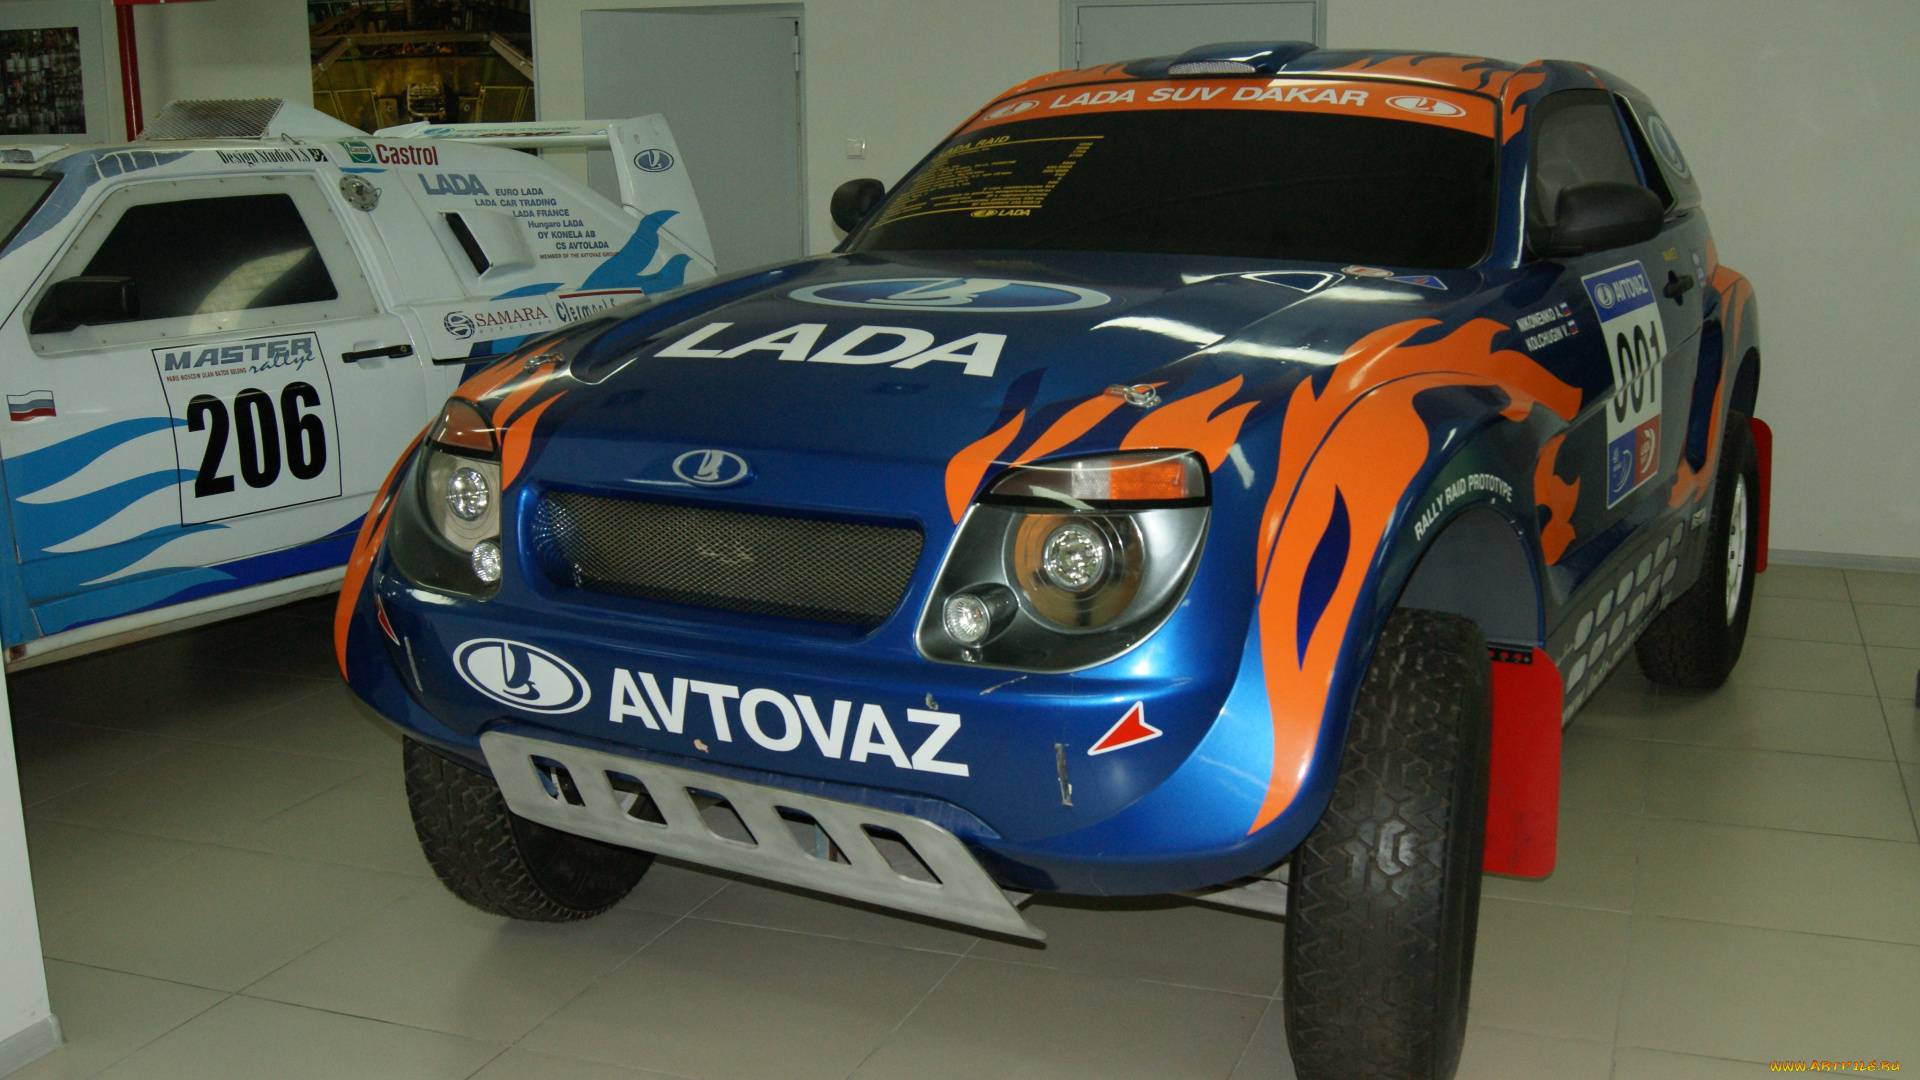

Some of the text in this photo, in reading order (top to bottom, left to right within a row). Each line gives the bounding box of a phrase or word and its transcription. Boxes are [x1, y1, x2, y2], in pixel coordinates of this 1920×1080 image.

[1049, 87, 1369, 109] LADA SUV DAKAR
[976, 135, 1010, 148] RAID
[215, 150, 259, 168] Design
[254, 148, 294, 163] Studio
[375, 144, 439, 166] Castrol
[417, 173, 489, 195] LADA
[495, 187, 544, 196] EURO LADA
[500, 199, 518, 207] CAR
[518, 198, 557, 206] TRADING
[513, 209, 570, 218] LADA FRANCE
[528, 219, 585, 230] Hungaro LADA
[537, 231, 549, 239] OY
[552, 231, 583, 239] KONELA
[556, 241, 610, 250] CS AVTOLADA
[1612, 273, 1649, 302] AVTOVAZ
[474, 306, 548, 327] SAMARA
[165, 337, 312, 371] MASTER
[653, 322, 1008, 377] LADA
[249, 349, 316, 374] rallye
[1614, 320, 1661, 423] 001
[166, 374, 180, 382] PARIS
[181, 373, 201, 381] MOSCOW
[215, 369, 229, 377] BATOR
[187, 381, 327, 498] 206
[1414, 473, 1513, 541] RALLY RAID PROTOTYPE
[609, 667, 970, 777] AVTOVAZ
